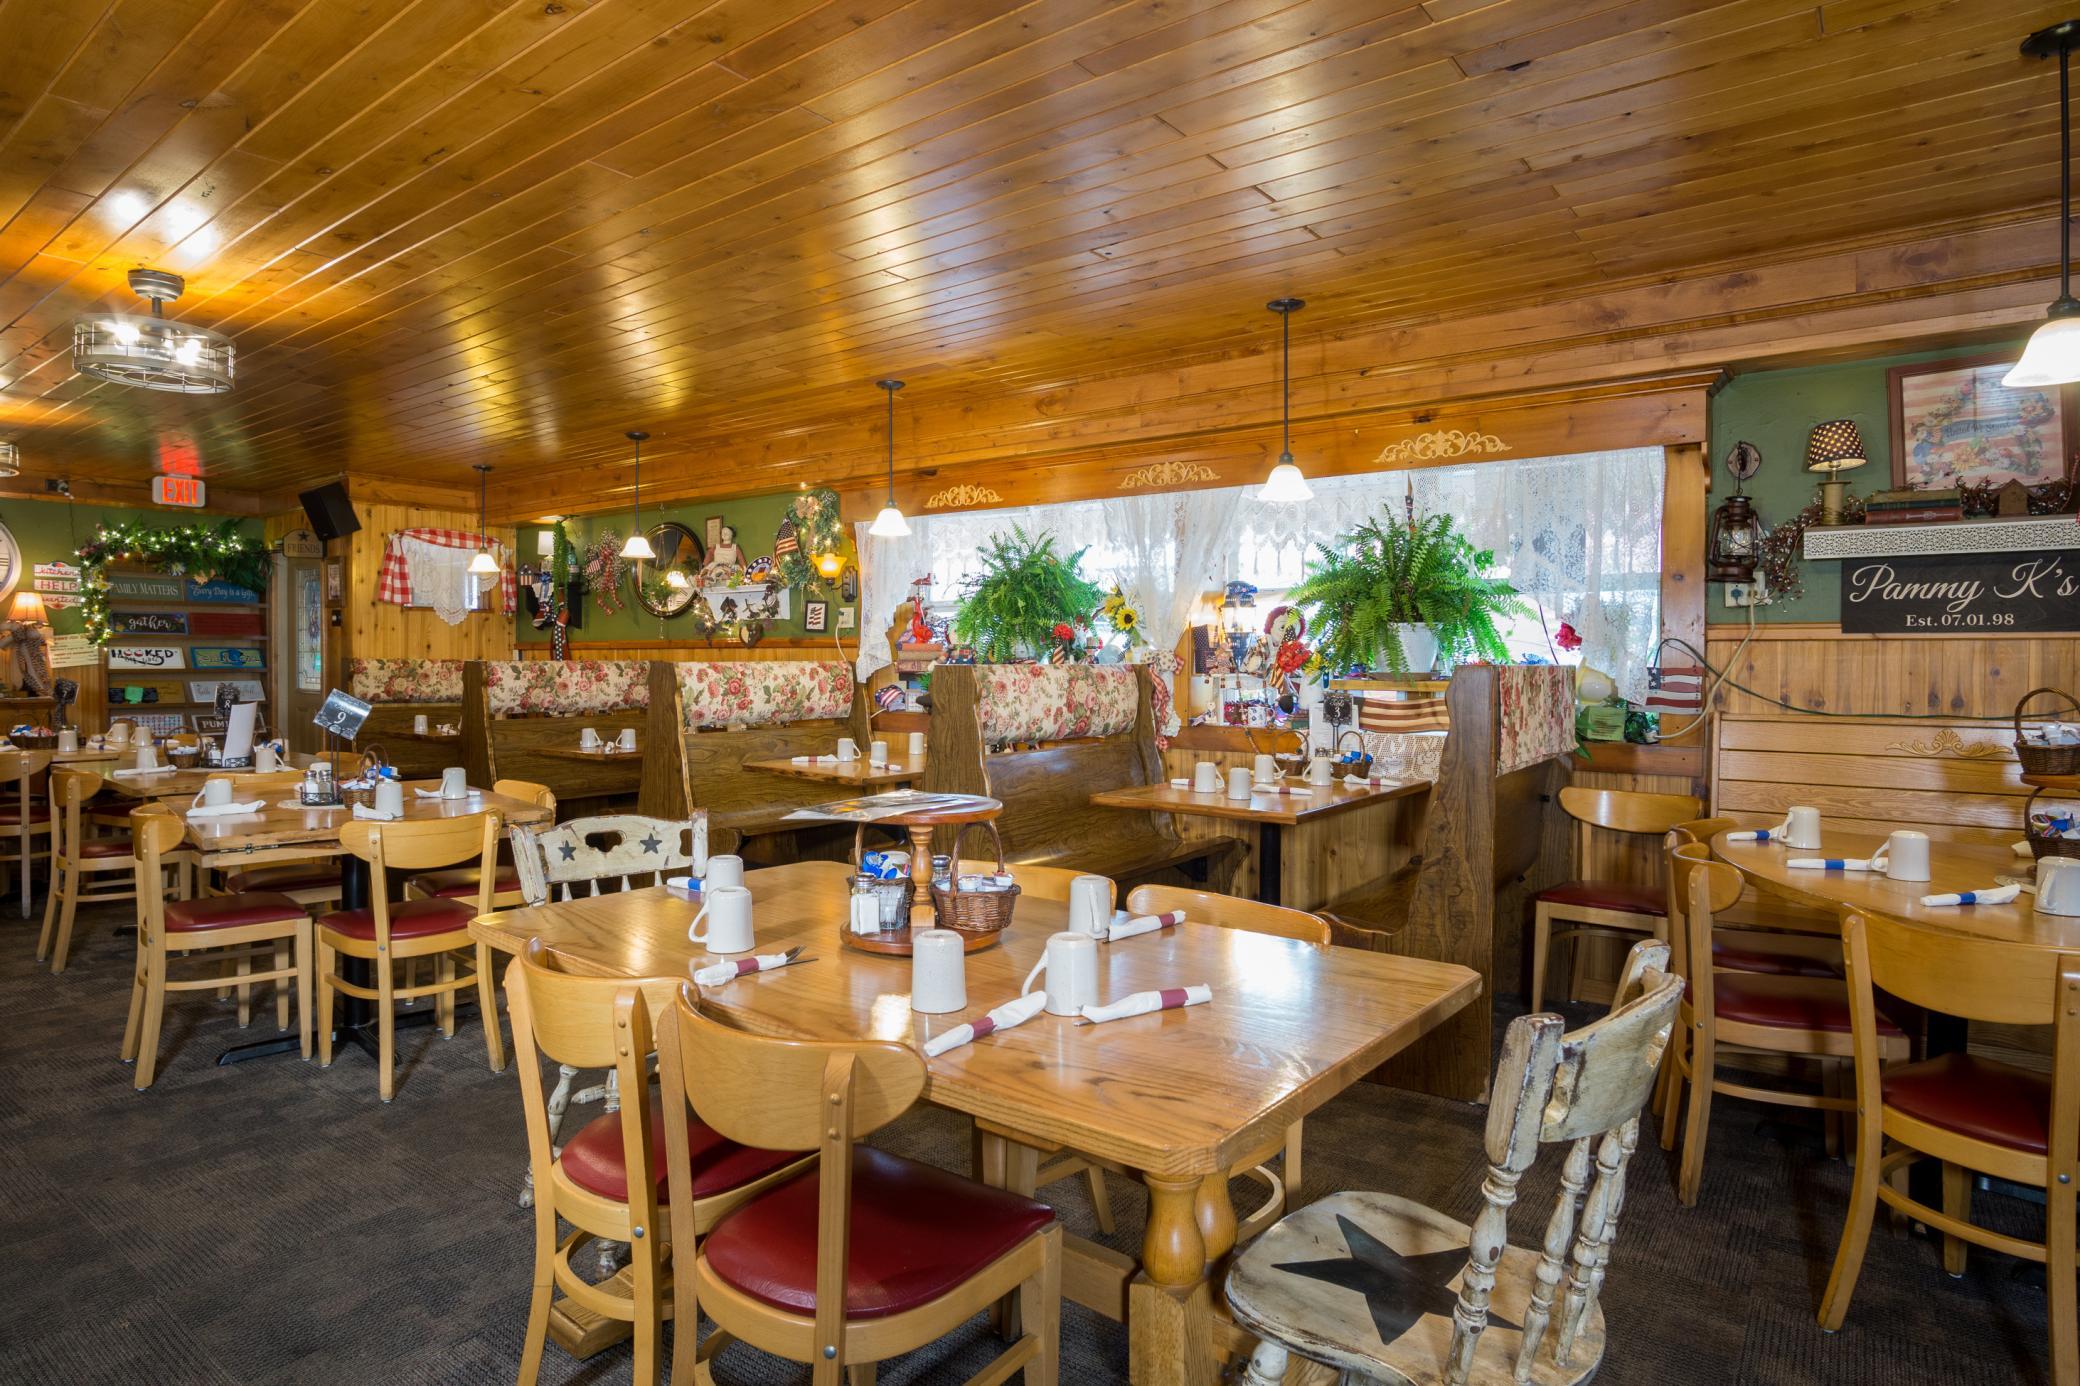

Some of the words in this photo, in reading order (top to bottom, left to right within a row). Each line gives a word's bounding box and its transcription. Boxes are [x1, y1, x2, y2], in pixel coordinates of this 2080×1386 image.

[163, 478, 198, 505] EXIT
[287, 543, 320, 553] FRIENDS
[40, 580, 77, 591] HELP
[139, 583, 179, 596] MATTERS
[1849, 563, 1985, 612] Pammy
[1993, 556, 2079, 599] K's
[128, 615, 171, 629] gather
[1905, 614, 1938, 627] Est.
[1941, 614, 2015, 626] 07.01.98
[333, 711, 346, 724] 9
